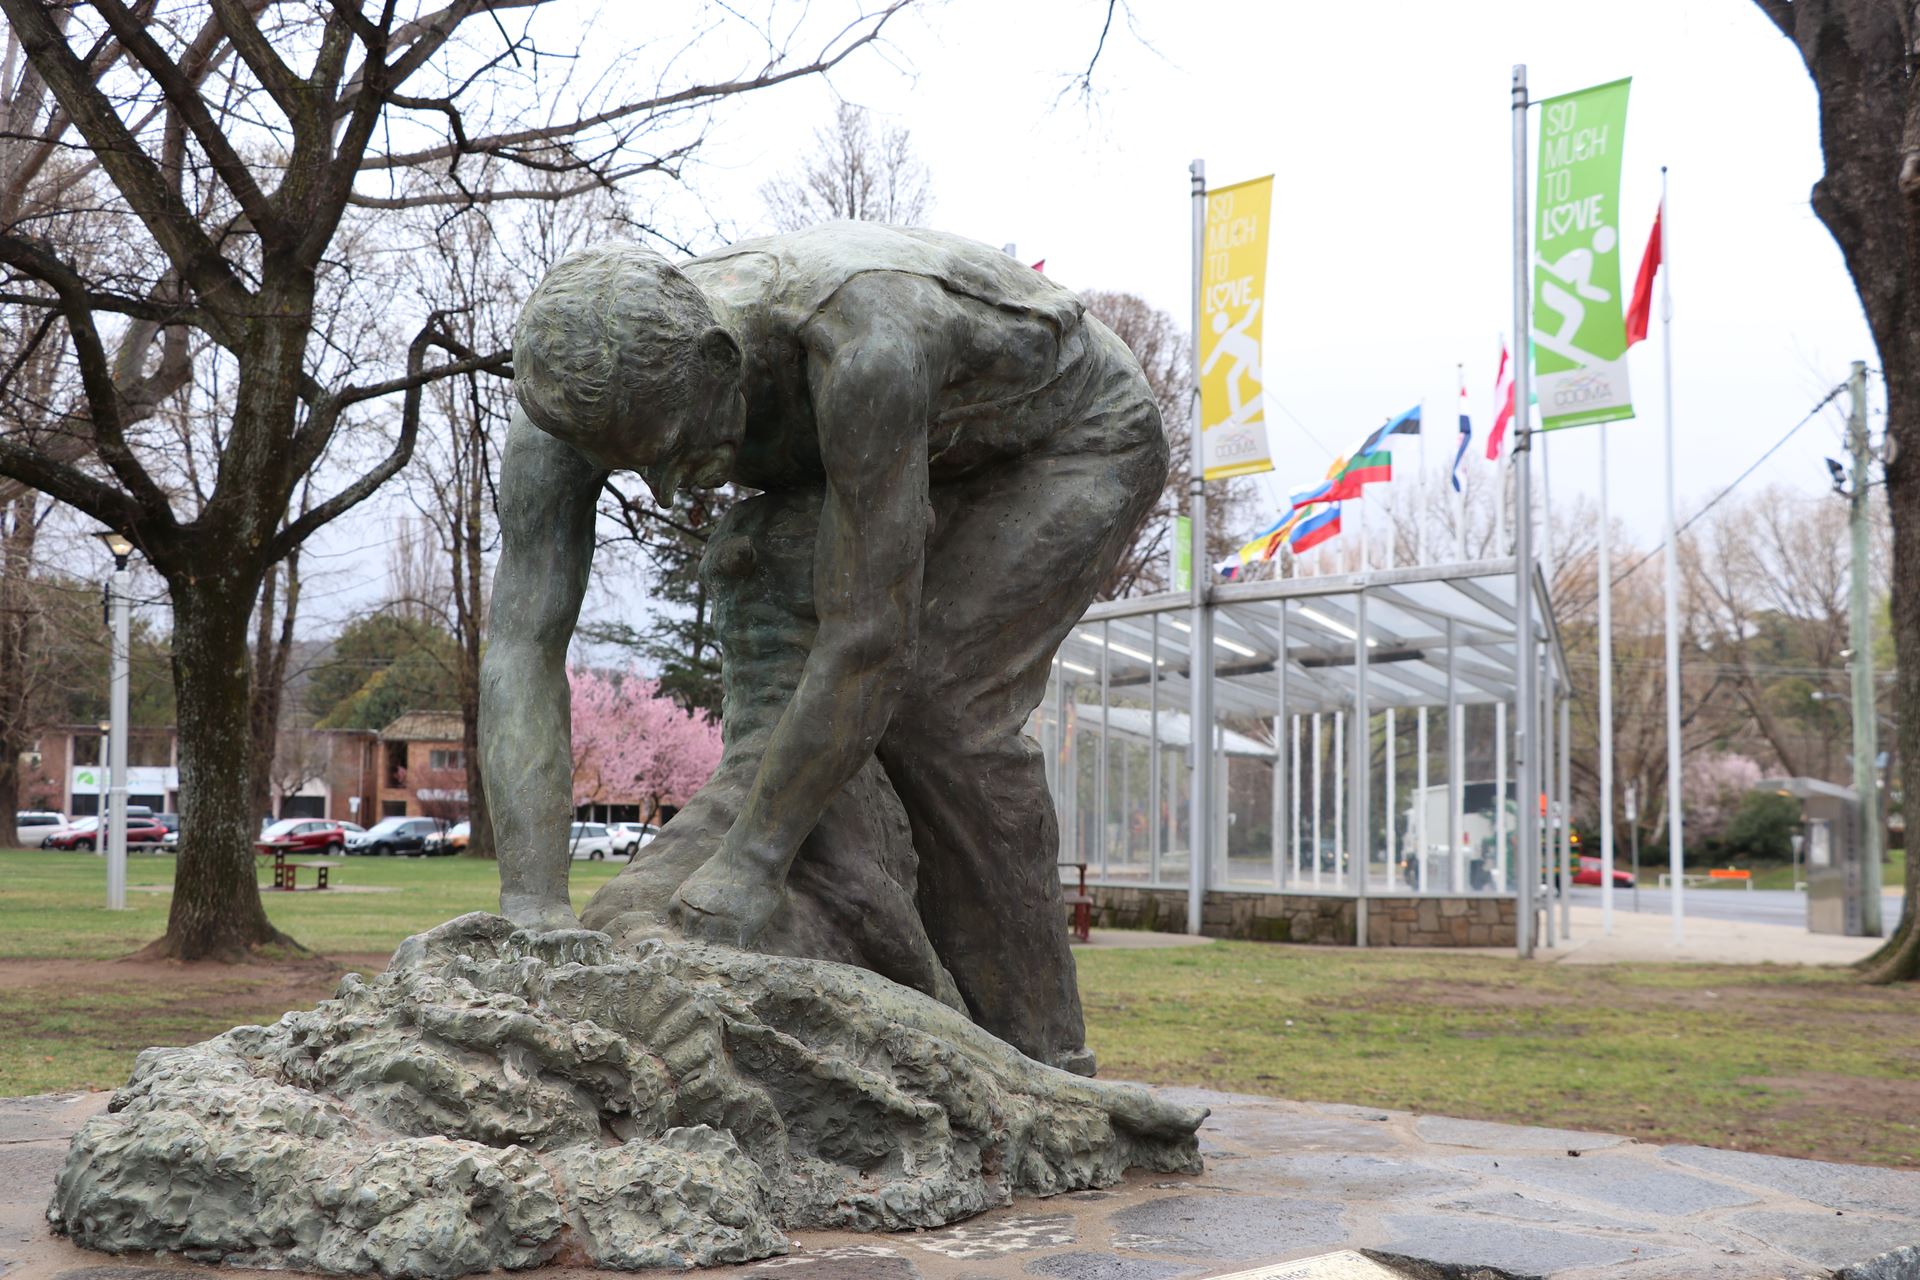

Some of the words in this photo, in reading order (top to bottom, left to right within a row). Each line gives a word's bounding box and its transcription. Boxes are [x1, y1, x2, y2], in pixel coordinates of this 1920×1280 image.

[1547, 100, 1577, 136] SO
[1544, 125, 1609, 170] MUCH
[1544, 168, 1570, 203] TO
[1211, 191, 1233, 224] SO
[1208, 215, 1257, 254] MUCH
[1207, 252, 1229, 282] TO
